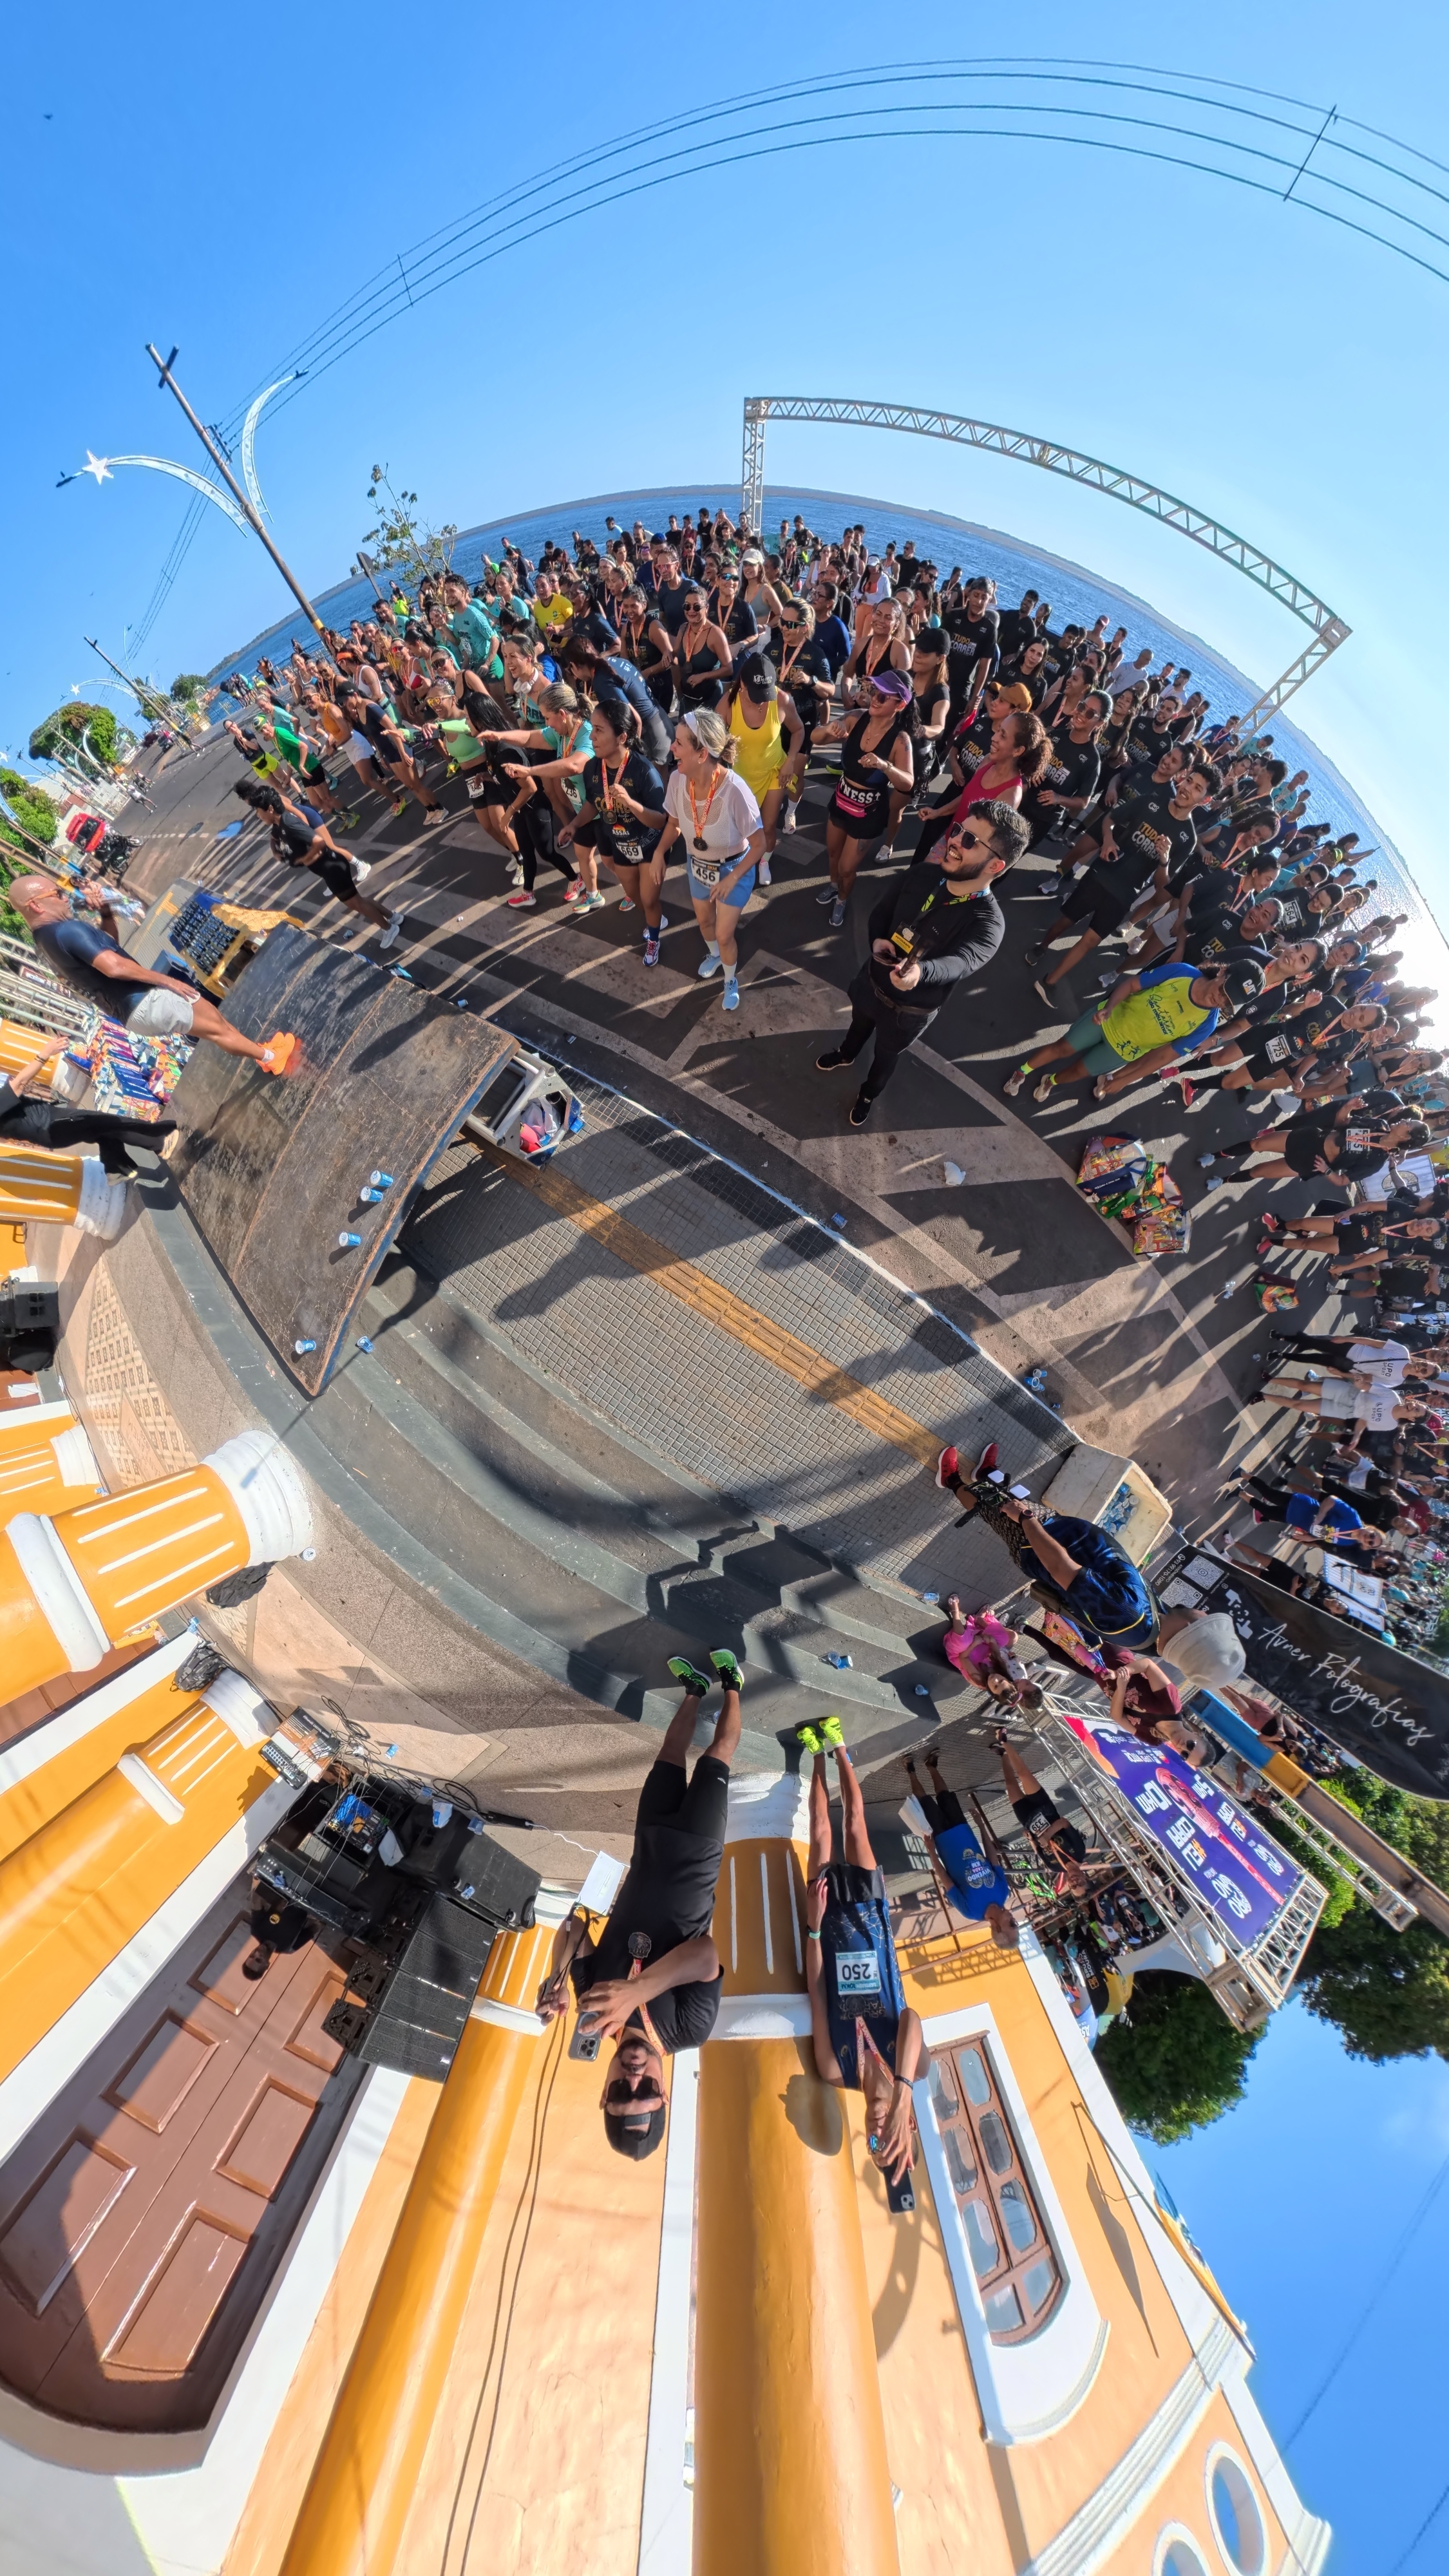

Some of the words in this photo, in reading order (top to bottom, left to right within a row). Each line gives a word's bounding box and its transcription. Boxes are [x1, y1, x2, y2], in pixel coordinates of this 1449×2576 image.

[696, 868, 716, 882] 456
[1283, 905, 1295, 921] 564
[1242, 979, 1256, 995] CAT
[1152, 1009, 1162, 1021] meu
[1159, 1021, 1168, 1036] amor
[1271, 1042, 1285, 1058] 725
[1258, 1623, 1312, 1662] Avner
[1309, 1653, 1435, 1747] Fotografias
[1031, 1818, 1044, 1832] 339
[967, 1868, 991, 1882] VIVENDO
[842, 1963, 872, 1981] 250
